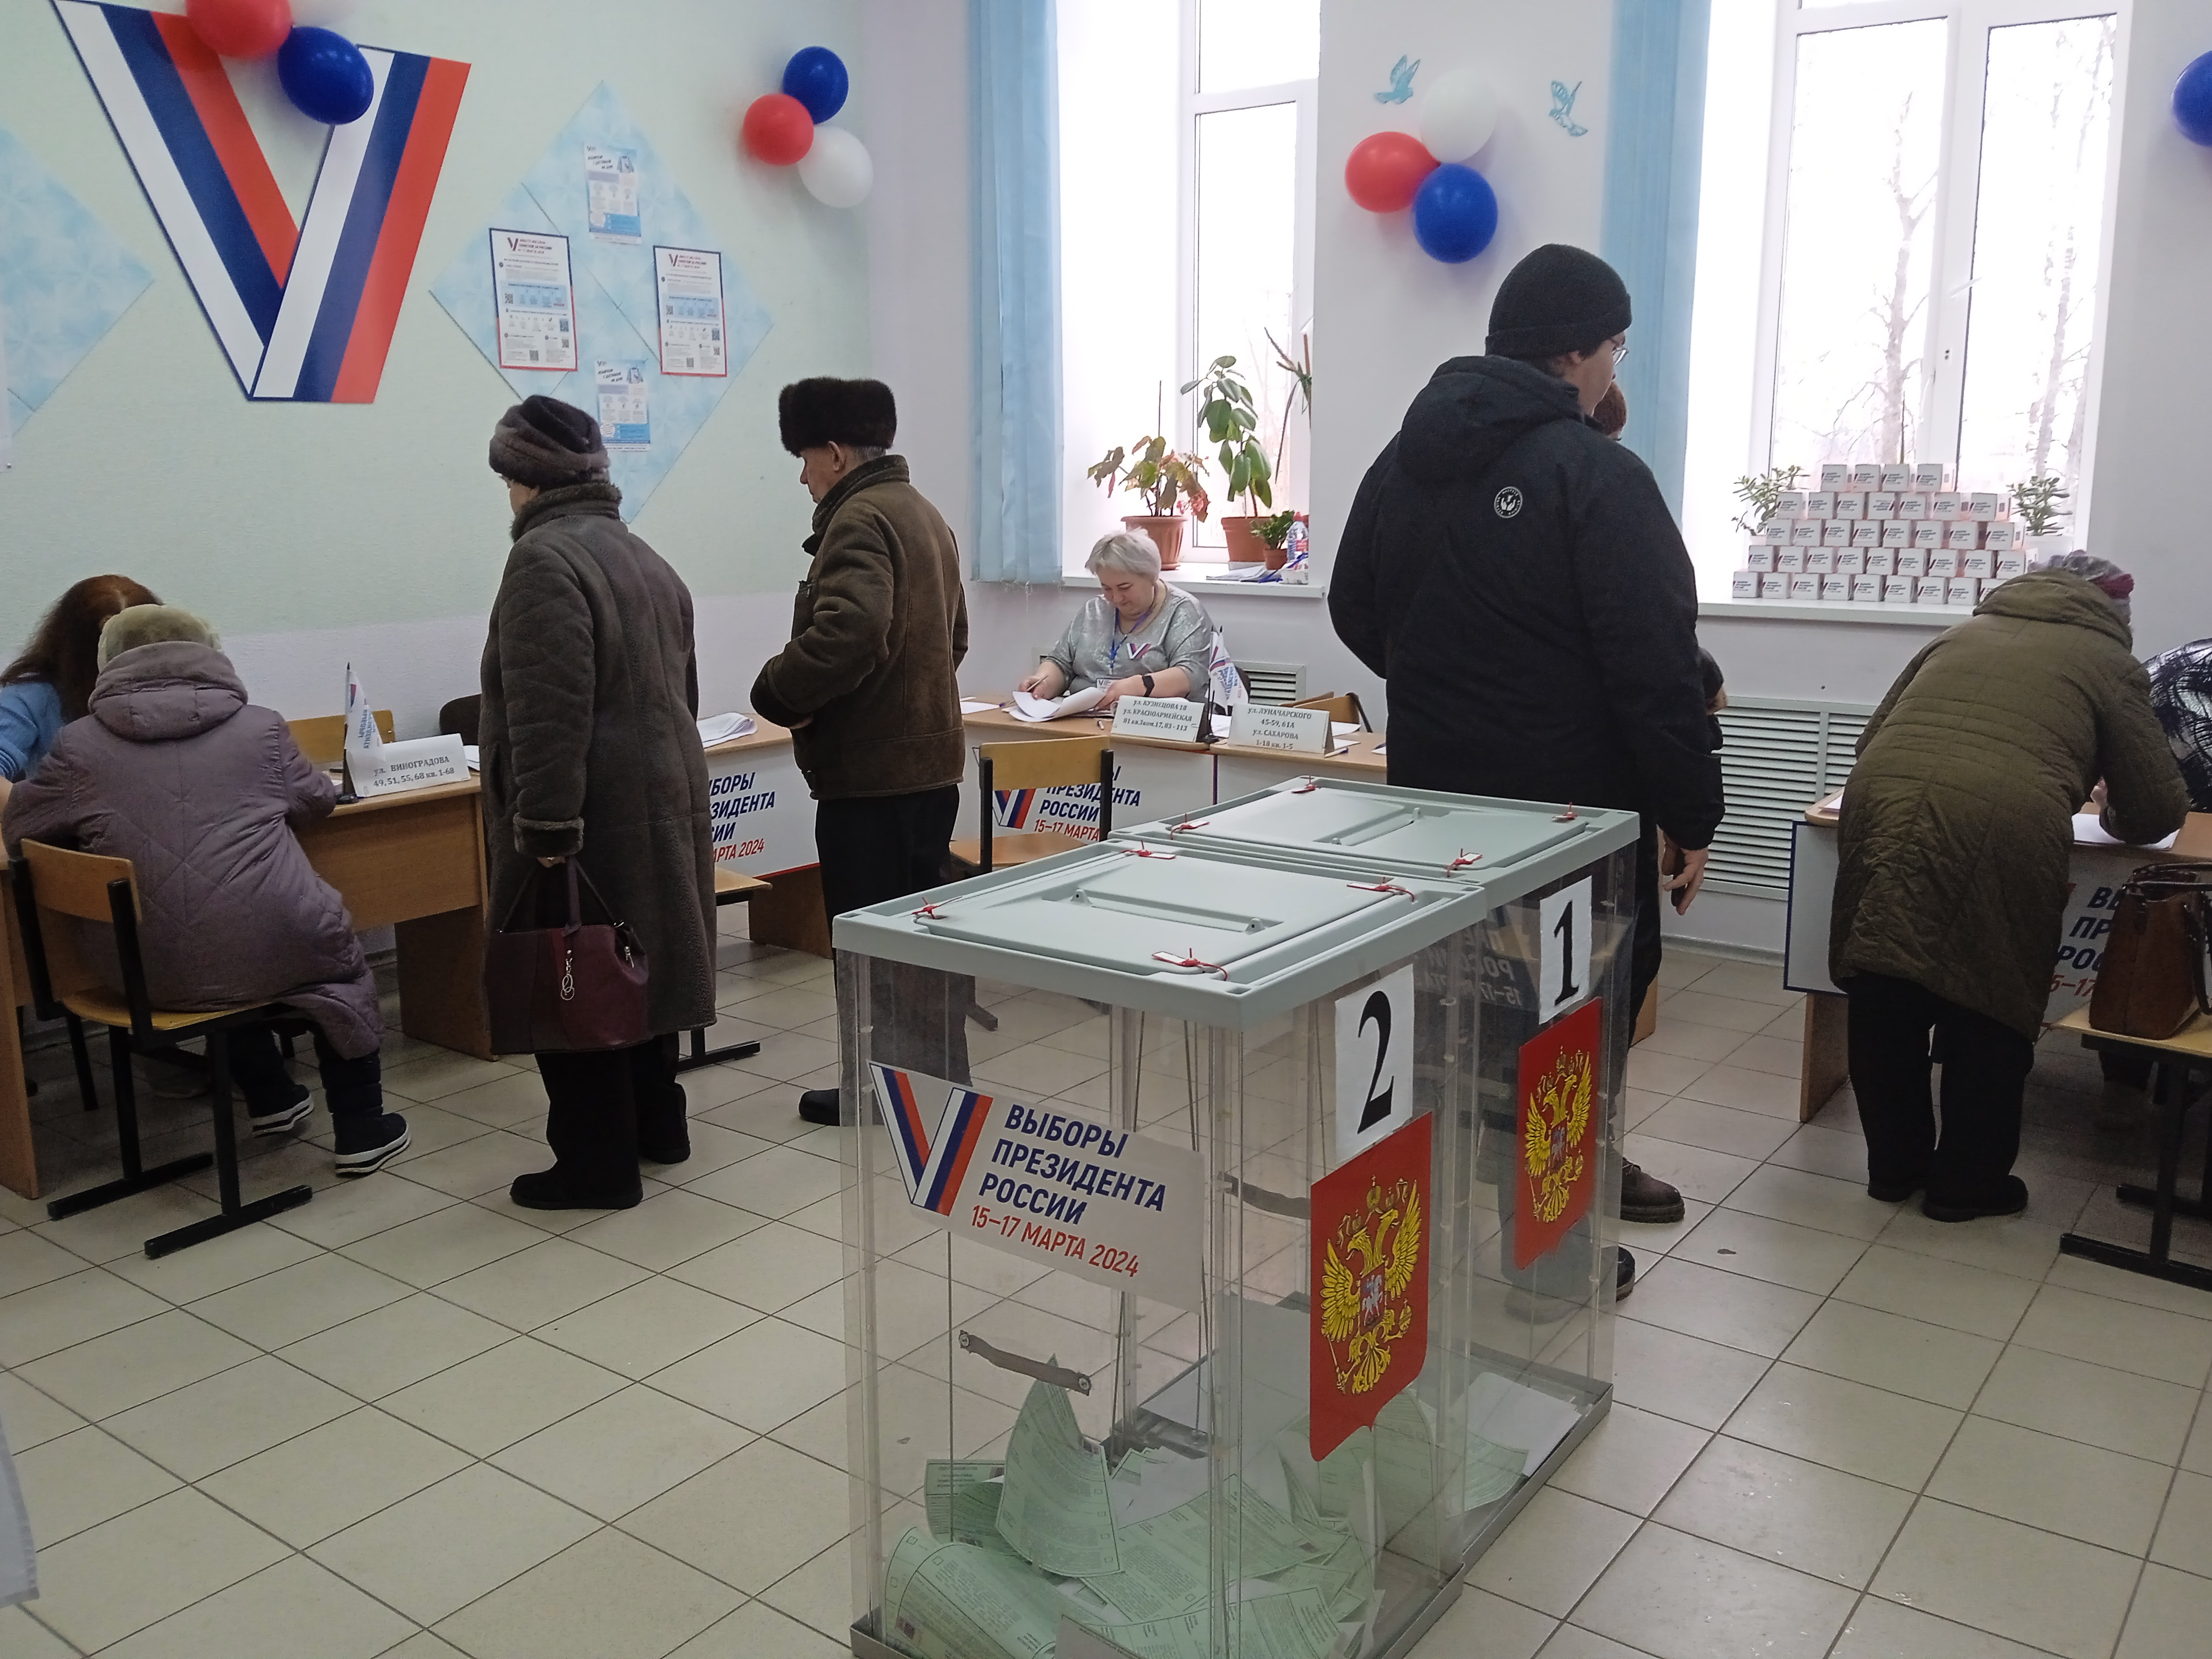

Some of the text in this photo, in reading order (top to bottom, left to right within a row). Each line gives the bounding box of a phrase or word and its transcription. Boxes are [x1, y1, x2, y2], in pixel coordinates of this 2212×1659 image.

[1133, 709, 1193, 722] КРАСНОАРМЕЙСКАЯ
[1143, 700, 1178, 709] КУЗНЕЦОВА
[1258, 708, 1312, 719] ЛУНАЧАРСКОГО
[1264, 730, 1298, 740] САХАРОВА
[391, 756, 450, 772] ВИНОГРАДОВА
[439, 767, 455, 776] 1-68
[710, 772, 755, 796] БОРЫ
[711, 791, 775, 819] ЗИДЕНТА
[1039, 800, 1100, 822] РОССИИ
[1064, 824, 1100, 841] МАРТА
[738, 839, 764, 857] 2024
[1554, 900, 1579, 1006] 1
[1358, 990, 1394, 1134] 2
[1004, 1103, 1129, 1159] ВЫБОРЫ
[991, 1138, 1167, 1212] ПРЕЗИДЕНТА
[978, 1172, 1088, 1225] РОССИИ
[1020, 1221, 1086, 1260] МАРТА
[1089, 1244, 1139, 1278] 2024
